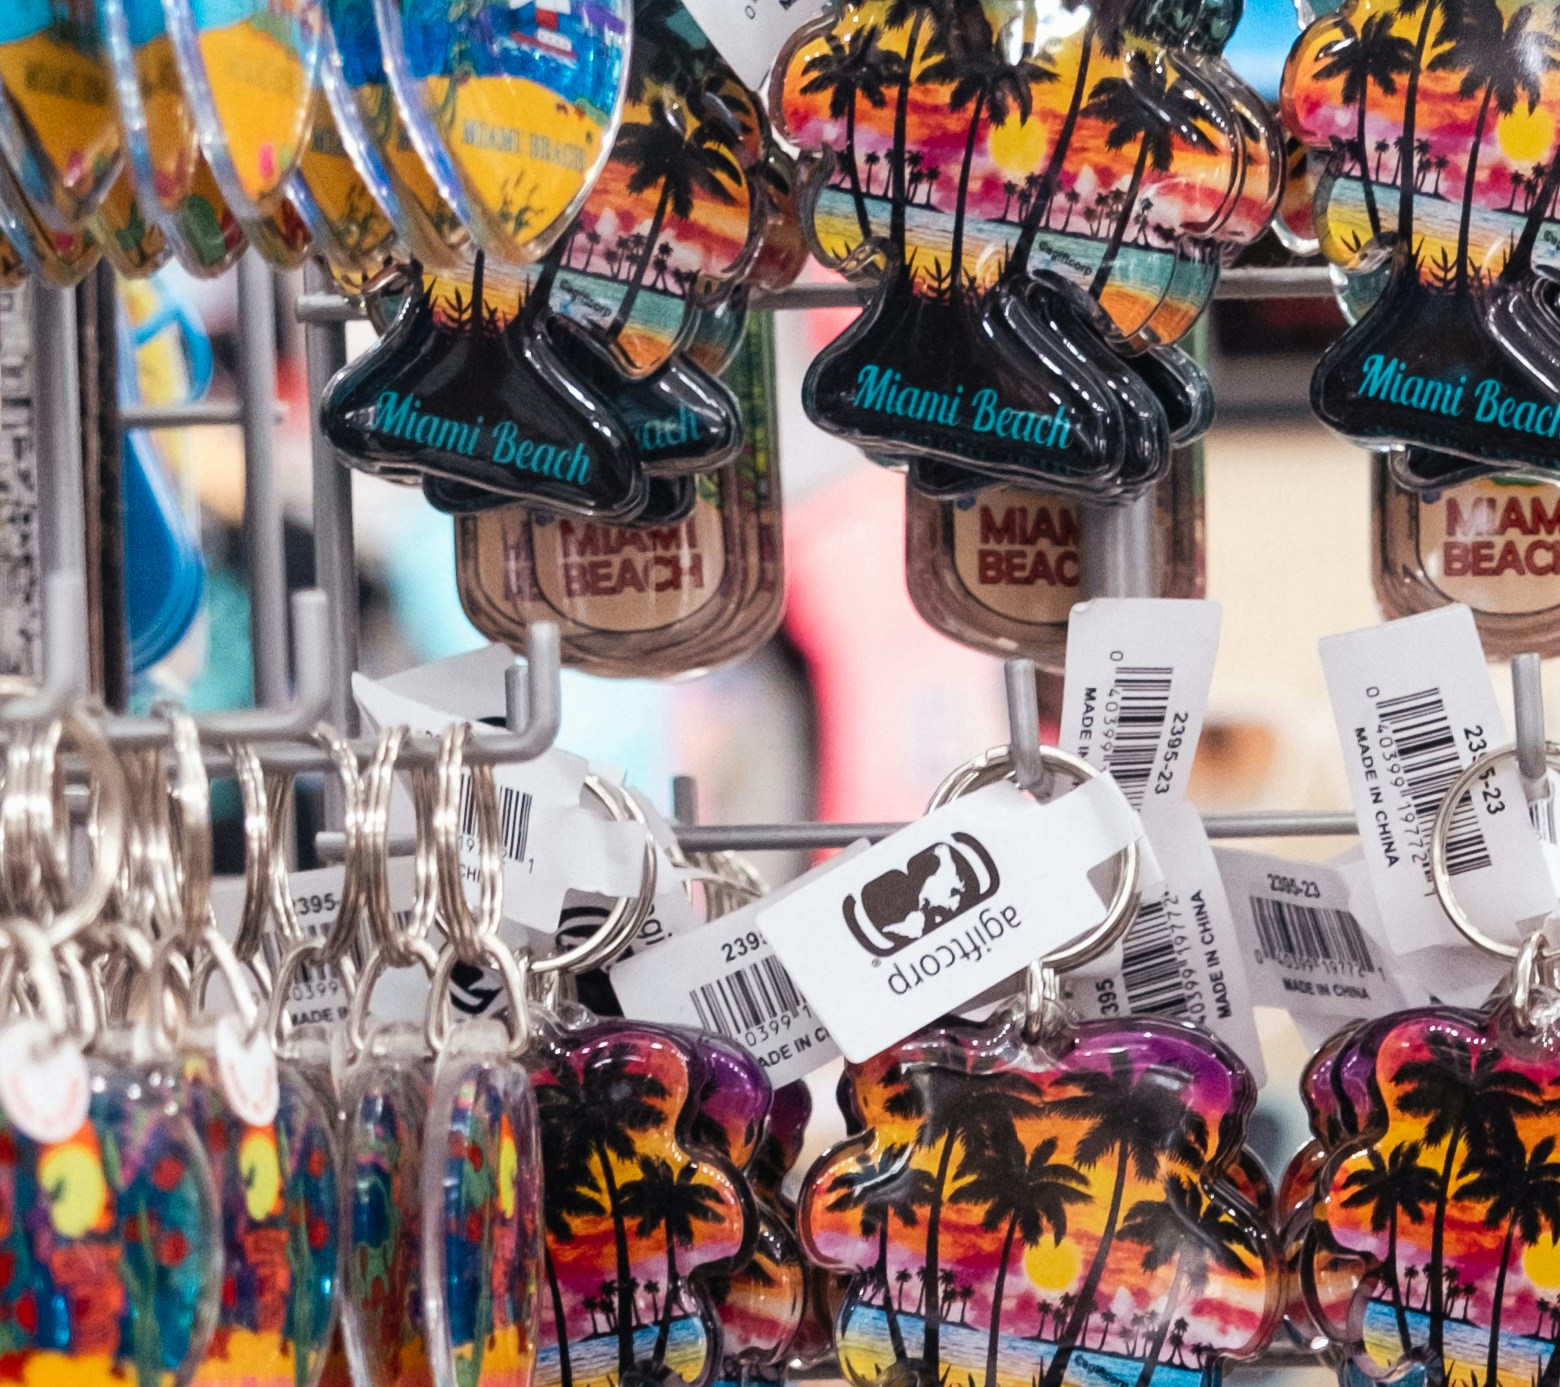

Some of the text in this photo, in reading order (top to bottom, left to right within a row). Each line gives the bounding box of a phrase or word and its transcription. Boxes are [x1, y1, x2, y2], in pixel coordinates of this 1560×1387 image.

[854, 365, 1073, 449] Miami Beach
[1357, 354, 1466, 417] Miami
[373, 389, 591, 486] Miami Beach
[563, 557, 704, 598] BEACH
[1079, 688, 1097, 741] MADE
[1154, 713, 1189, 794] 2395-23
[1462, 725, 1505, 815] 235-23
[1354, 727, 1400, 867] MADE IN CHINA
[1268, 874, 1320, 898] 2395-23
[1191, 889, 1232, 1018] MADE IN CHINA
[1282, 977, 1370, 999] MADE IN CHINA
[794, 1035, 811, 1054] IN
